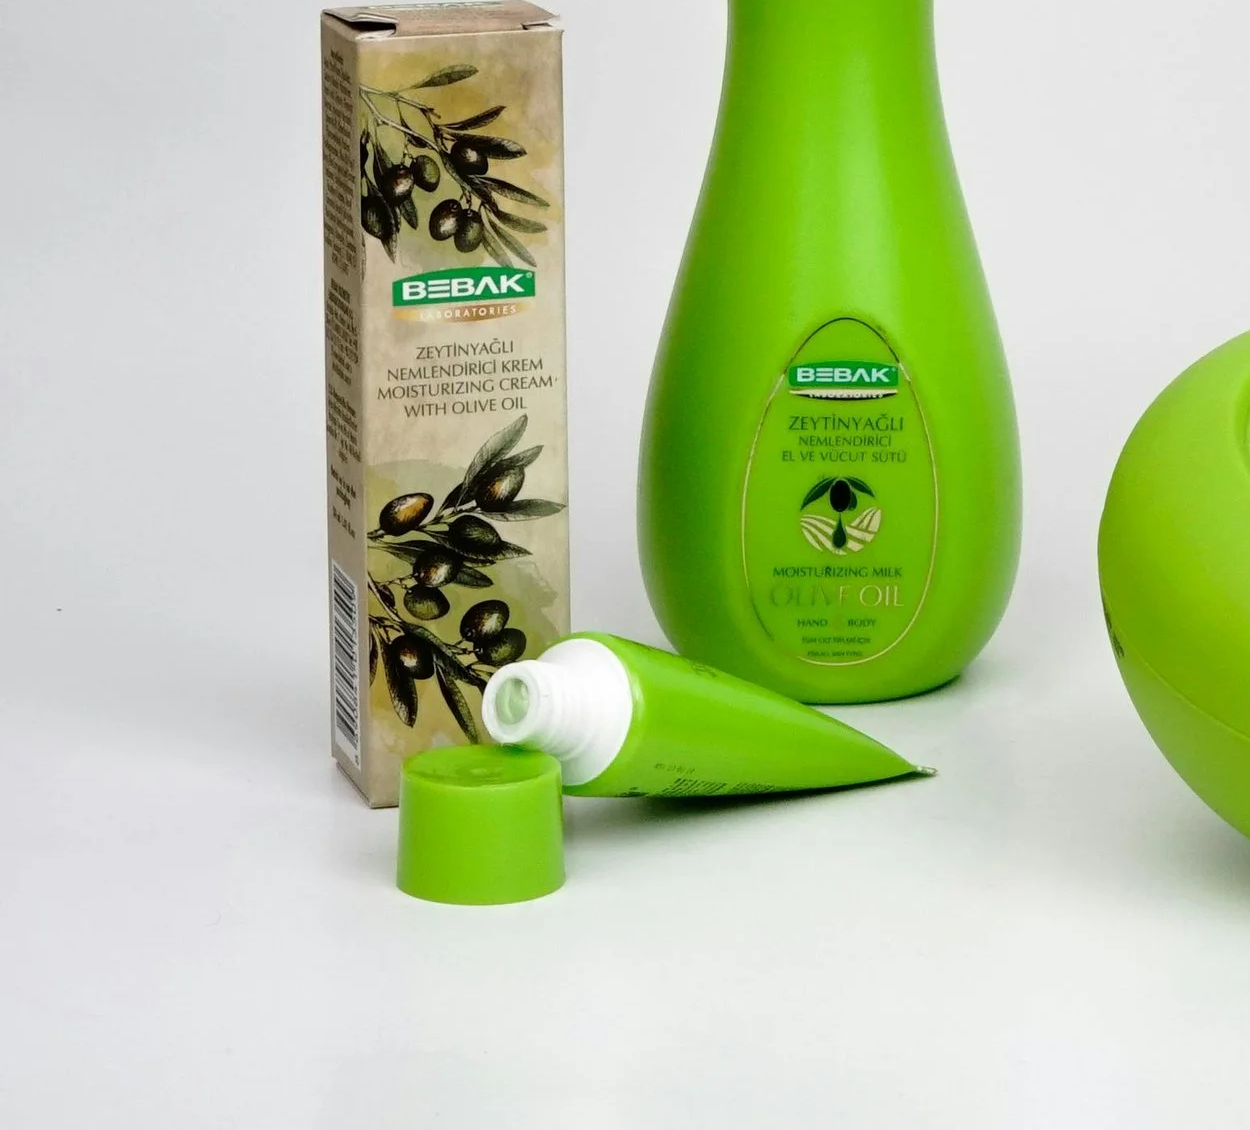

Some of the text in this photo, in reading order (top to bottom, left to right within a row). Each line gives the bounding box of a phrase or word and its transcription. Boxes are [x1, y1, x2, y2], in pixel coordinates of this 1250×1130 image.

[416, 338, 514, 360] ZEYTİNYAĞLI
[387, 357, 543, 382] NEMLENDİRİCİ KREM
[377, 376, 553, 400] MOISTURIZING CREAM
[404, 397, 528, 418] WITH OLIVE OIL
[788, 413, 904, 431] ZEYTİNYAĞLI
[782, 451, 795, 462] EL
[800, 451, 815, 462] VE
[773, 567, 903, 578] MOISTURIZING MILK
[859, 584, 905, 606] OIL
[797, 618, 828, 628] HAND
